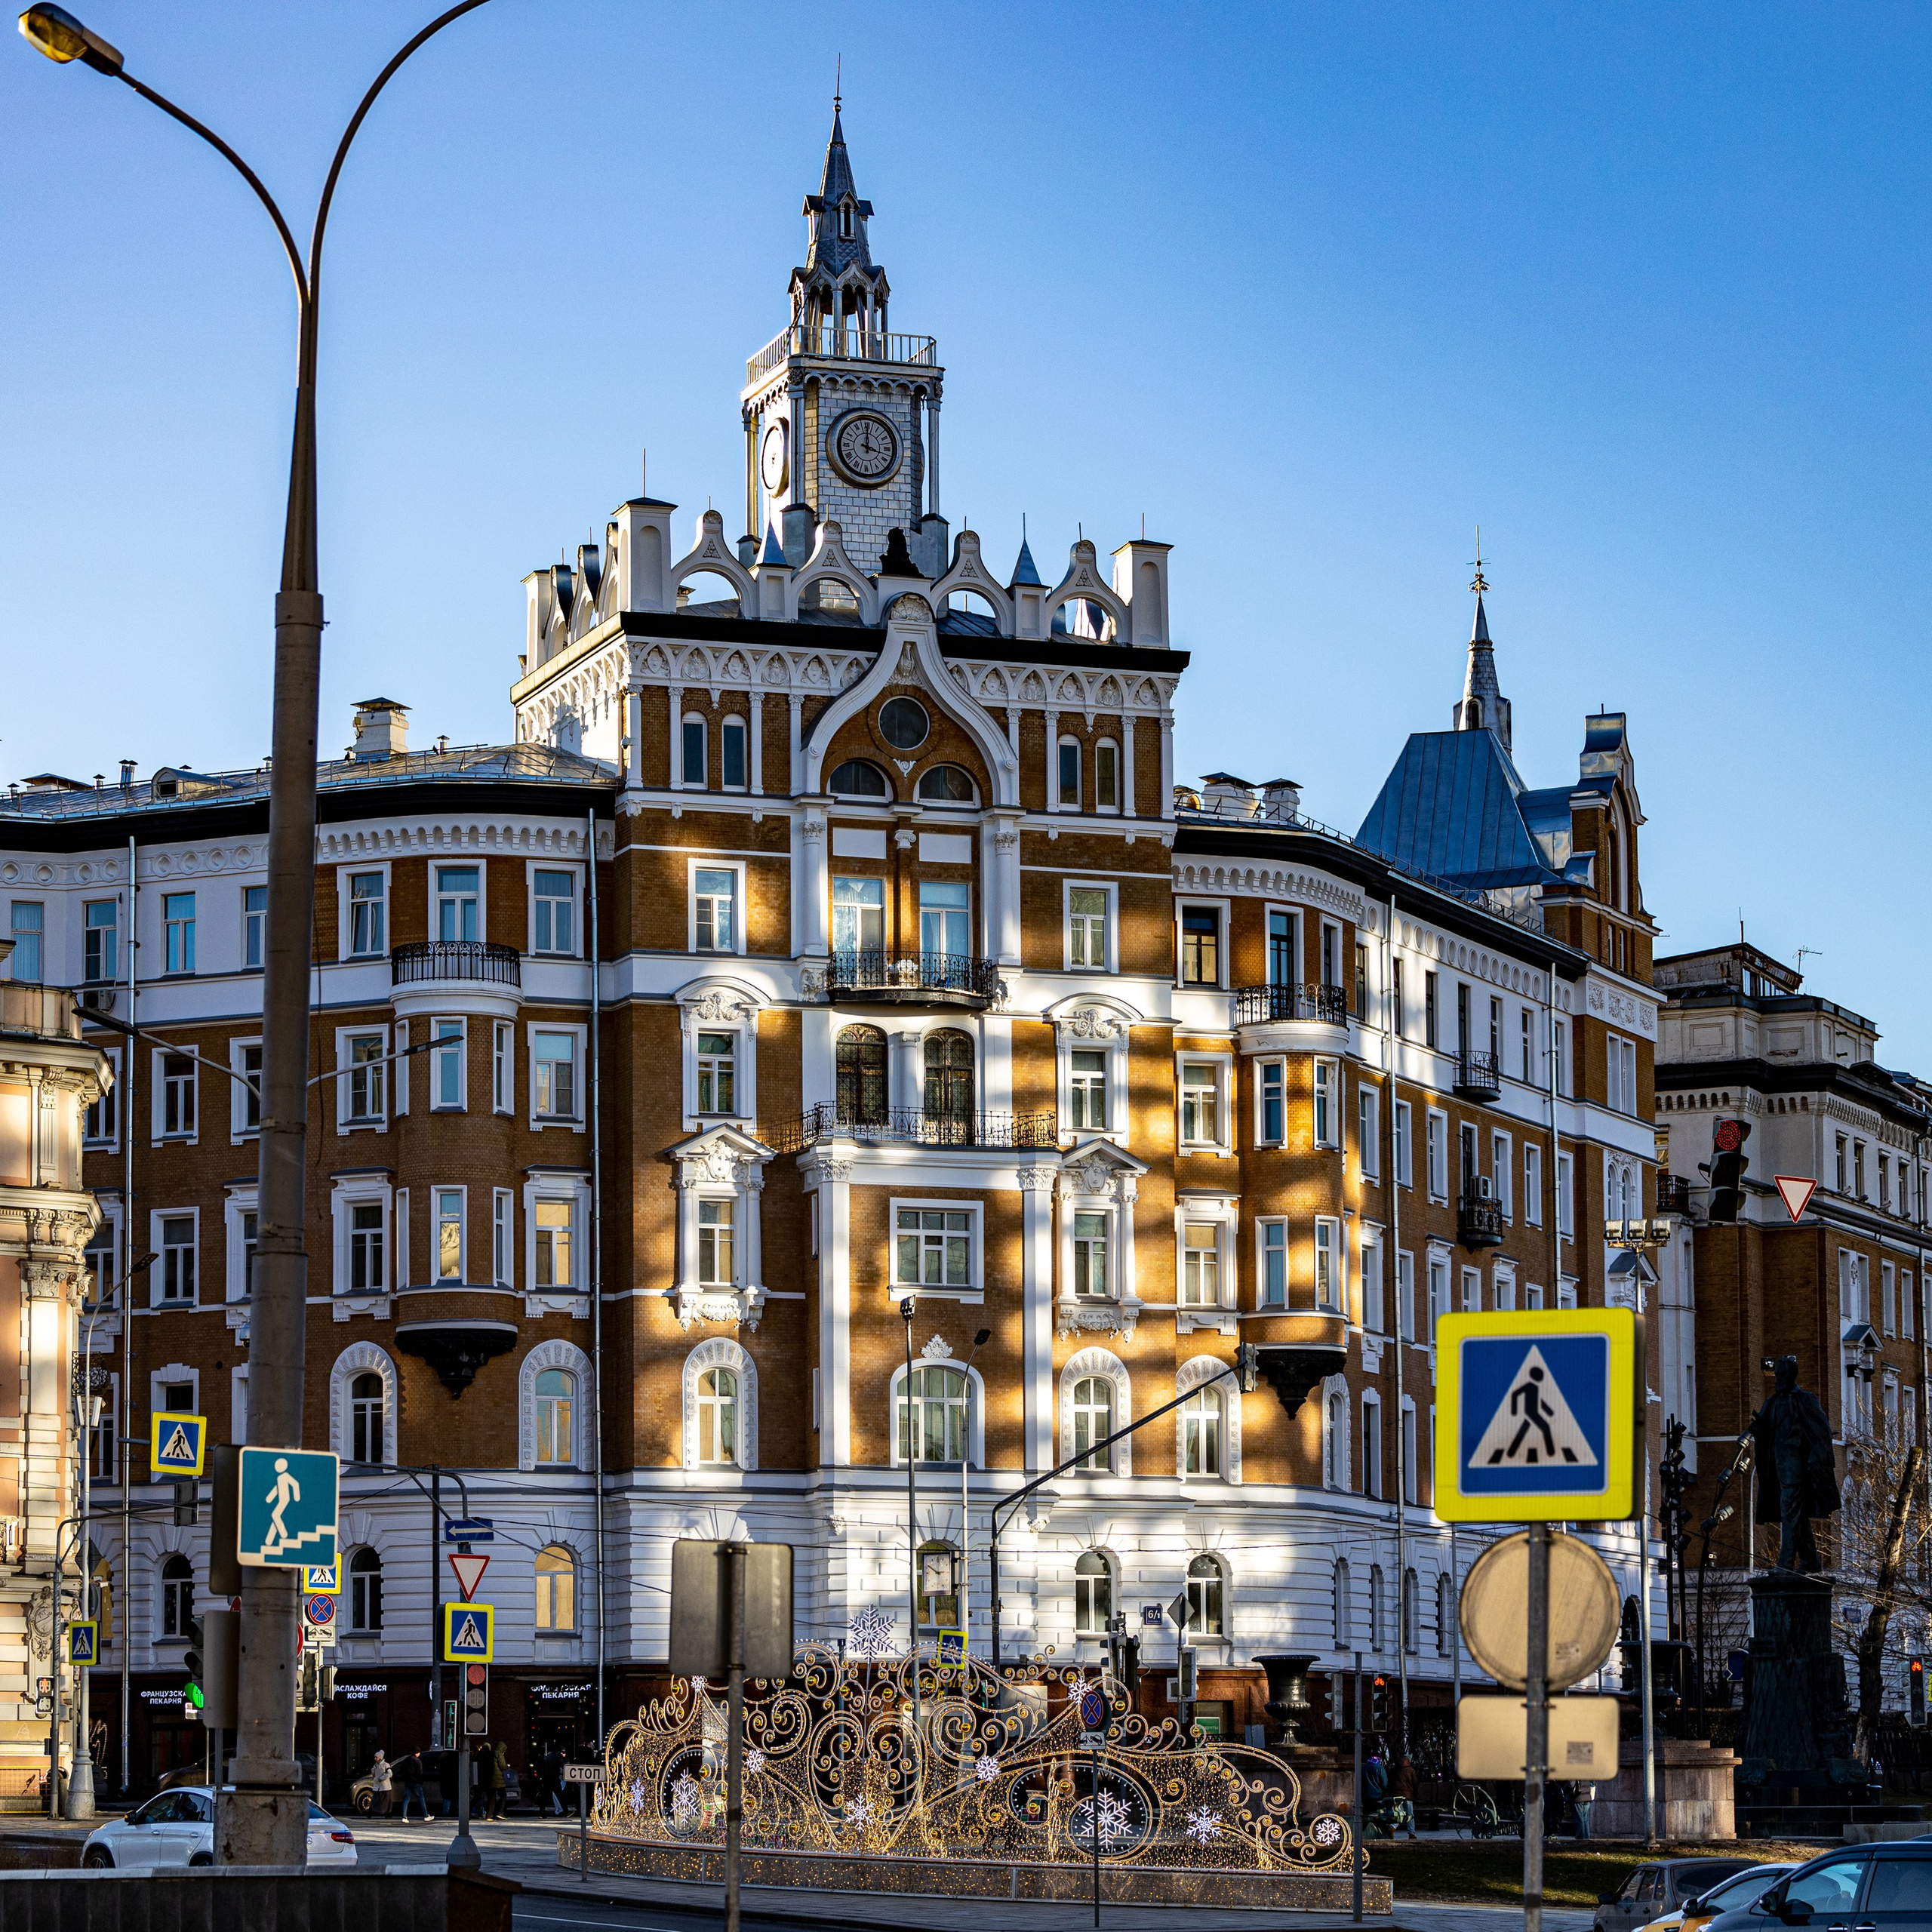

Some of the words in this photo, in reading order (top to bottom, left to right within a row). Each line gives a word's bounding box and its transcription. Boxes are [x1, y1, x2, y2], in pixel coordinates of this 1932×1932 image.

[1148, 1609, 1161, 1620] 6/1
[336, 1684, 387, 1692] АСЛАЖДАЙСЯ
[569, 1767, 601, 1780] СТОП
